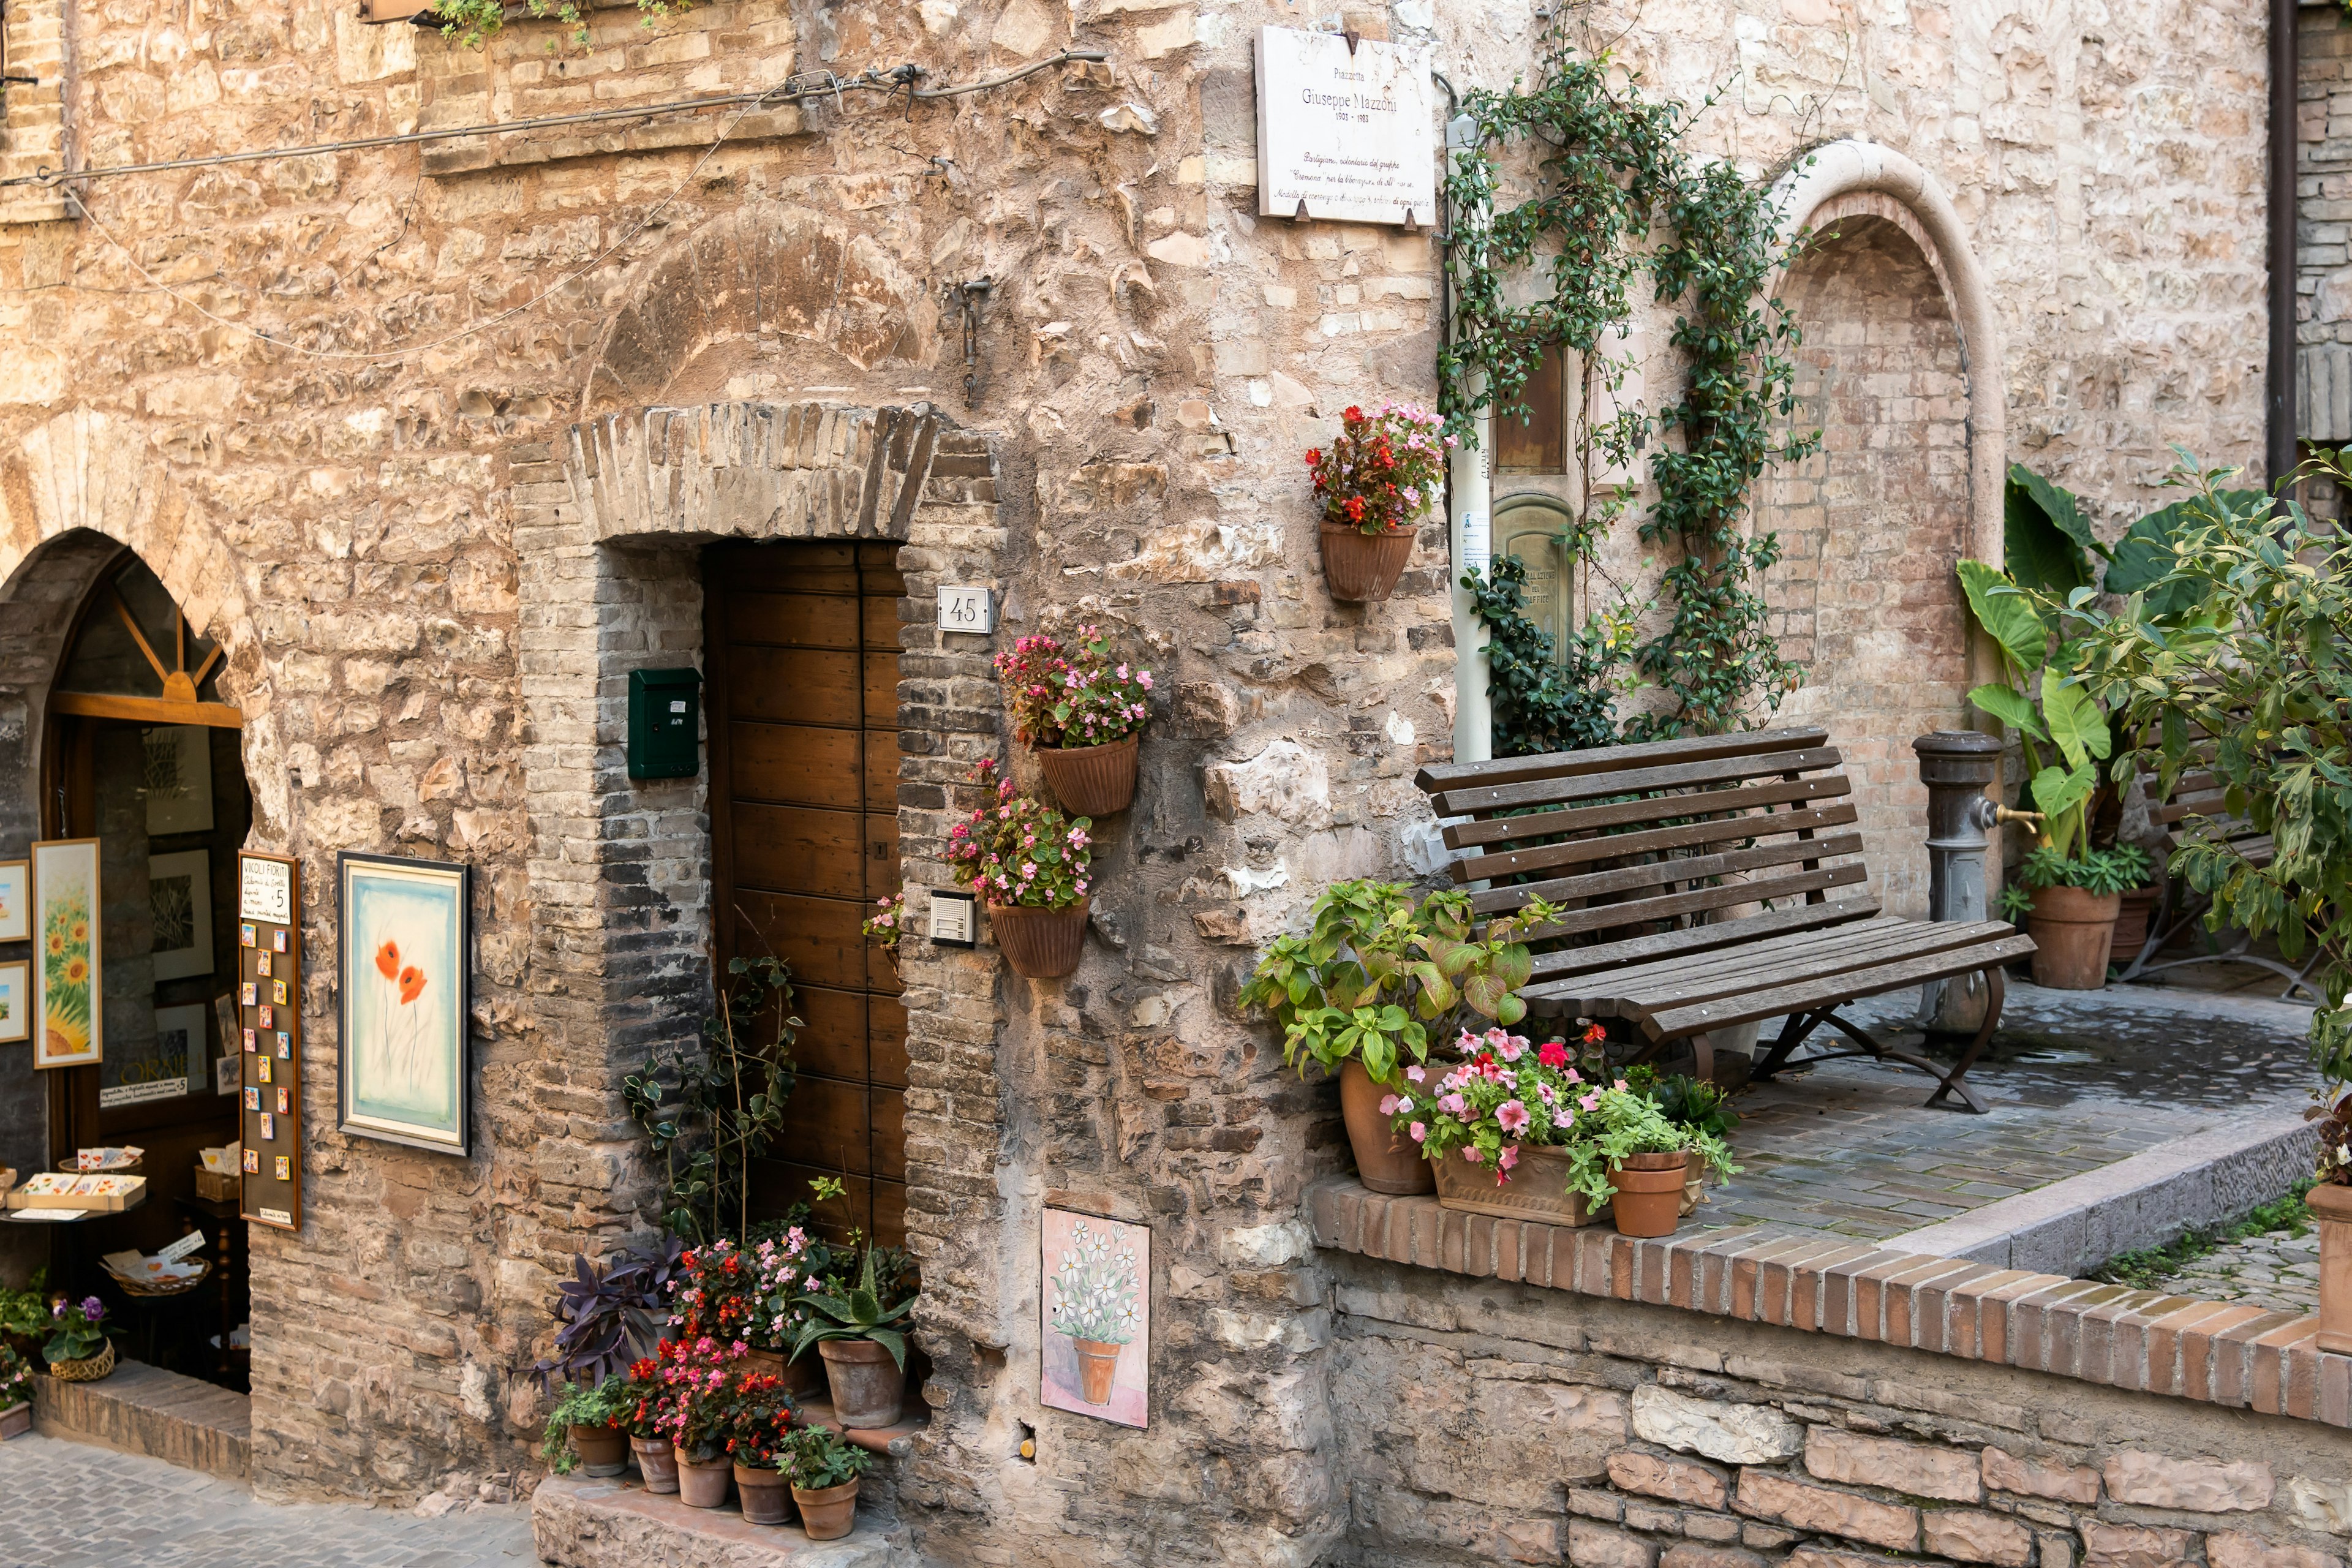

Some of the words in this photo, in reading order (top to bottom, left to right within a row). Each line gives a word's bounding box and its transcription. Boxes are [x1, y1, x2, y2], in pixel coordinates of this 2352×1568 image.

[1334, 67, 1365, 82] Piazzetta
[1302, 88, 1351, 111] Giuseppe
[1354, 92, 1397, 113] Mazzoni
[1336, 112, 1349, 121] 1903
[1357, 114, 1369, 123] 1983
[1303, 151, 1338, 168] Partigiano,
[1340, 156, 1368, 167] volontario
[1379, 160, 1400, 172] gruppo
[1325, 175, 1336, 186] per
[1337, 173, 1344, 183] la
[1376, 177, 1382, 186] di
[1300, 190, 1307, 199] di
[1392, 195, 1399, 205] di
[1400, 197, 1412, 210] ogni
[950, 598, 976, 622] 45
[244, 862, 265, 874] VICOLI
[267, 864, 287, 878] FIORITI
[277, 890, 284, 908] 5
[179, 1079, 186, 1090] 5
